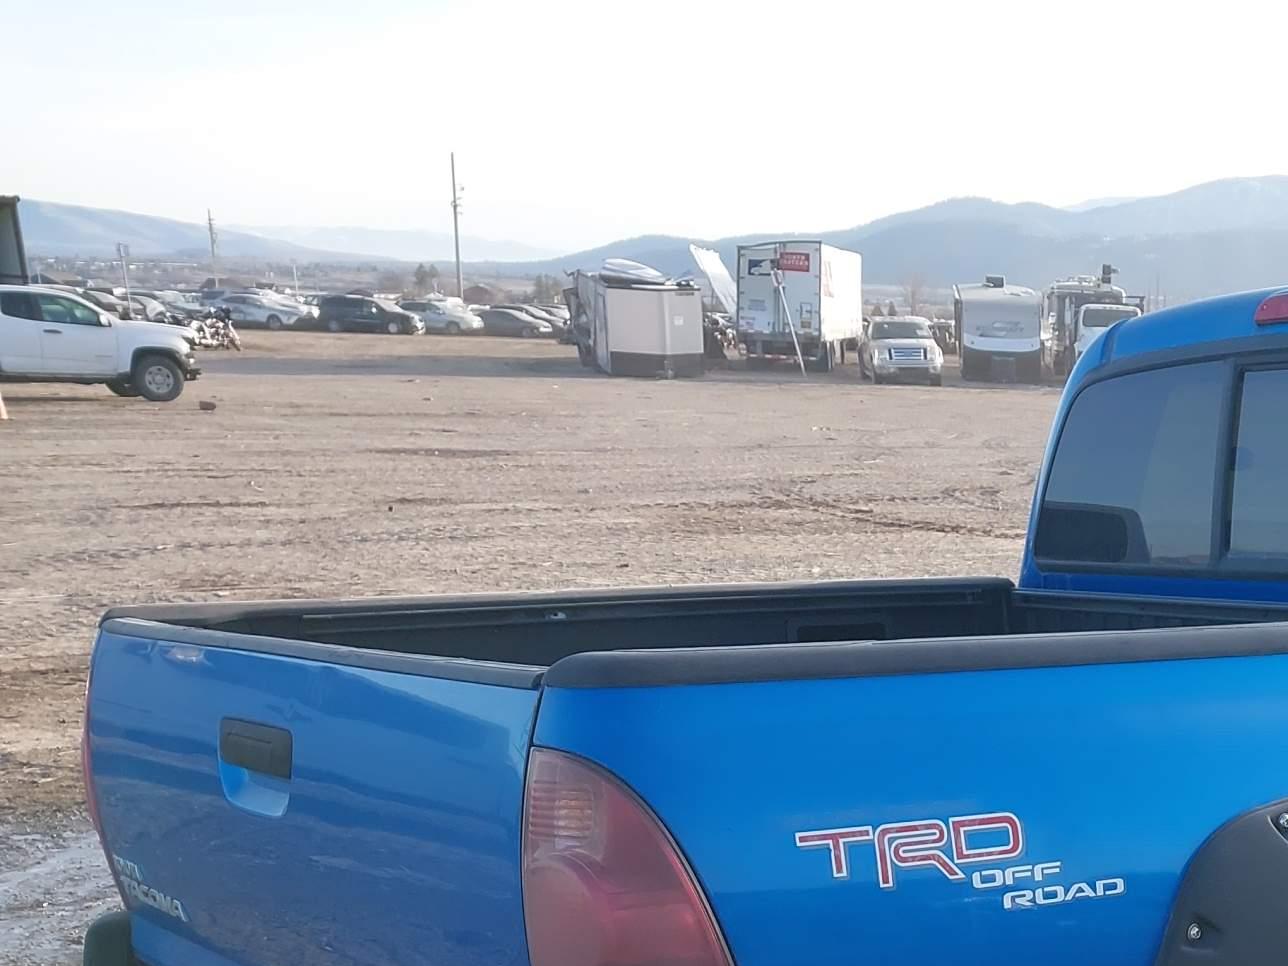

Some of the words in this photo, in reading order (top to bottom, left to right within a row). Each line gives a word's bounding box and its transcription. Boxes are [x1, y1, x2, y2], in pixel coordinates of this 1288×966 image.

[795, 812, 1022, 888] TRD
[972, 862, 1062, 889] OFF
[1003, 878, 1125, 910] ROAD
